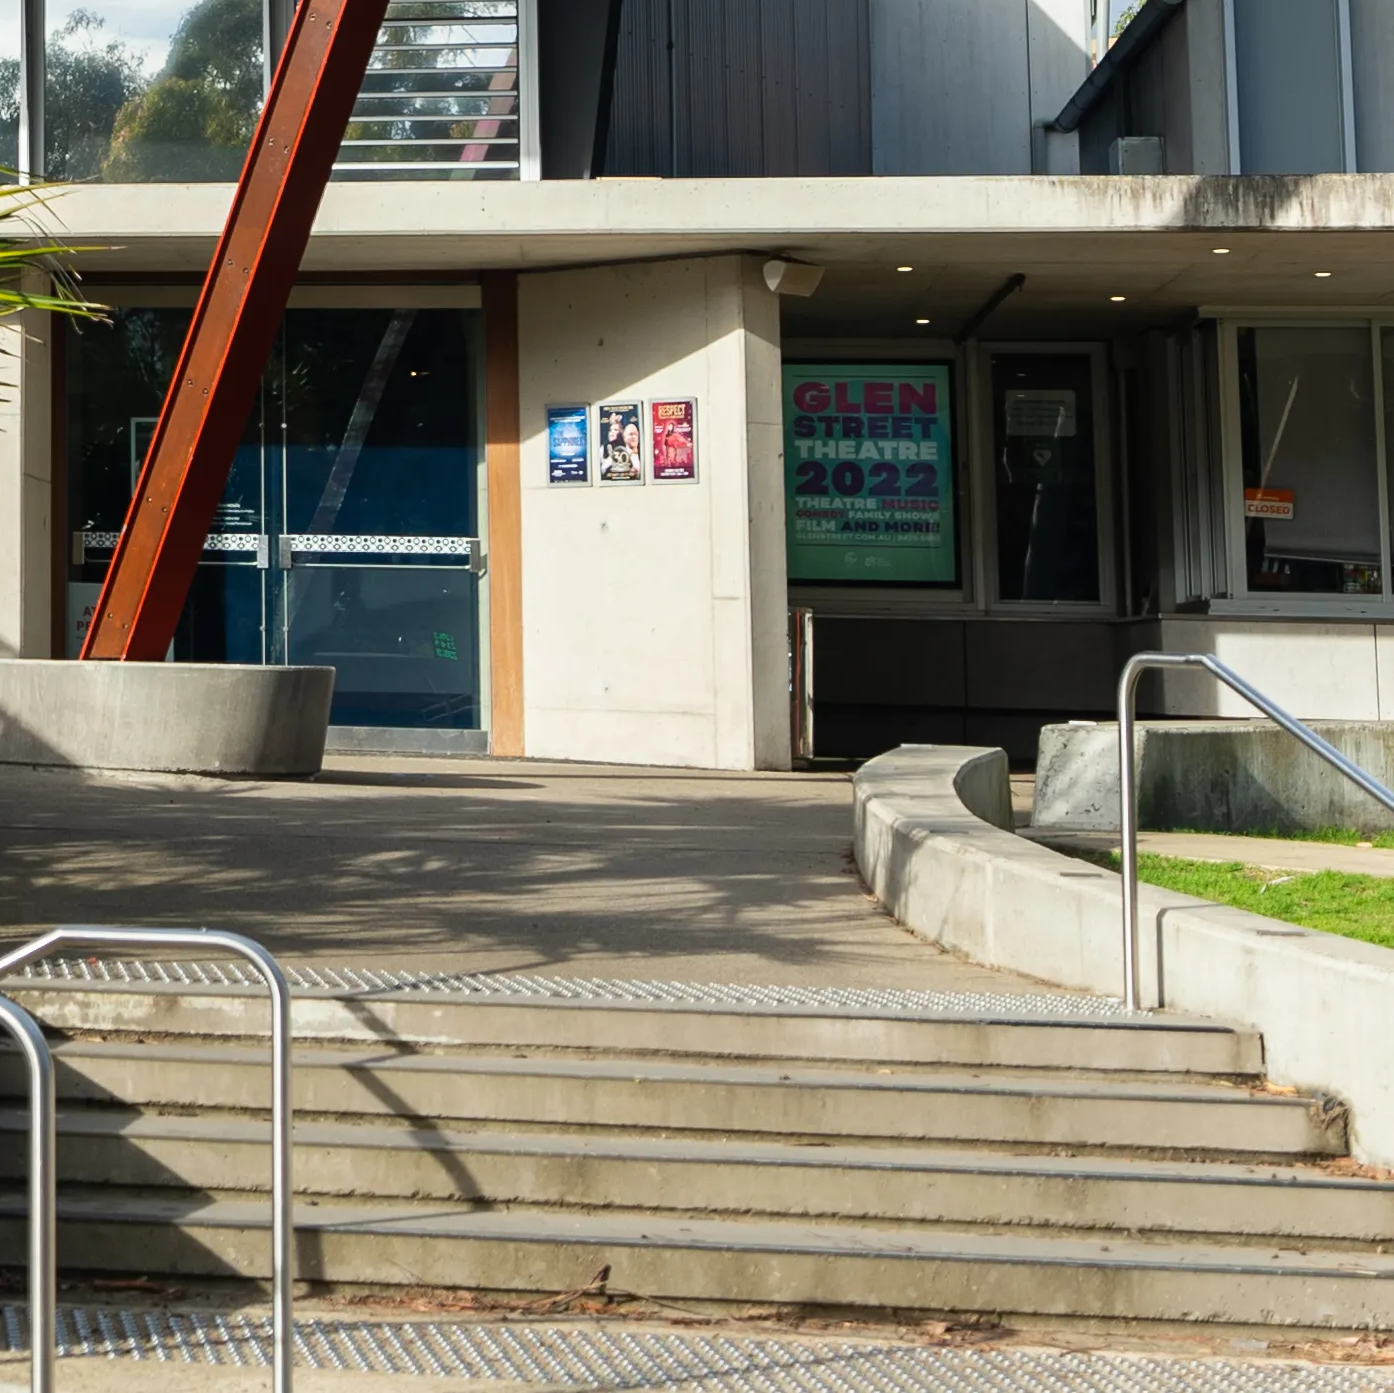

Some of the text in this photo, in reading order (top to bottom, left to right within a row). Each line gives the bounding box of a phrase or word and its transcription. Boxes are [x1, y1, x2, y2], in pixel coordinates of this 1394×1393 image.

[793, 381, 936, 414] GLEN
[793, 415, 937, 438] STREET
[794, 440, 938, 460] THEATRE
[795, 461, 939, 497] 2022
[795, 497, 940, 510] THEATRE MUSIC
[1247, 503, 1290, 515] CLOSED
[795, 509, 940, 521] COMEDY FAMILY SHOWS
[795, 520, 836, 532] FILM
[841, 521, 880, 532] AND
